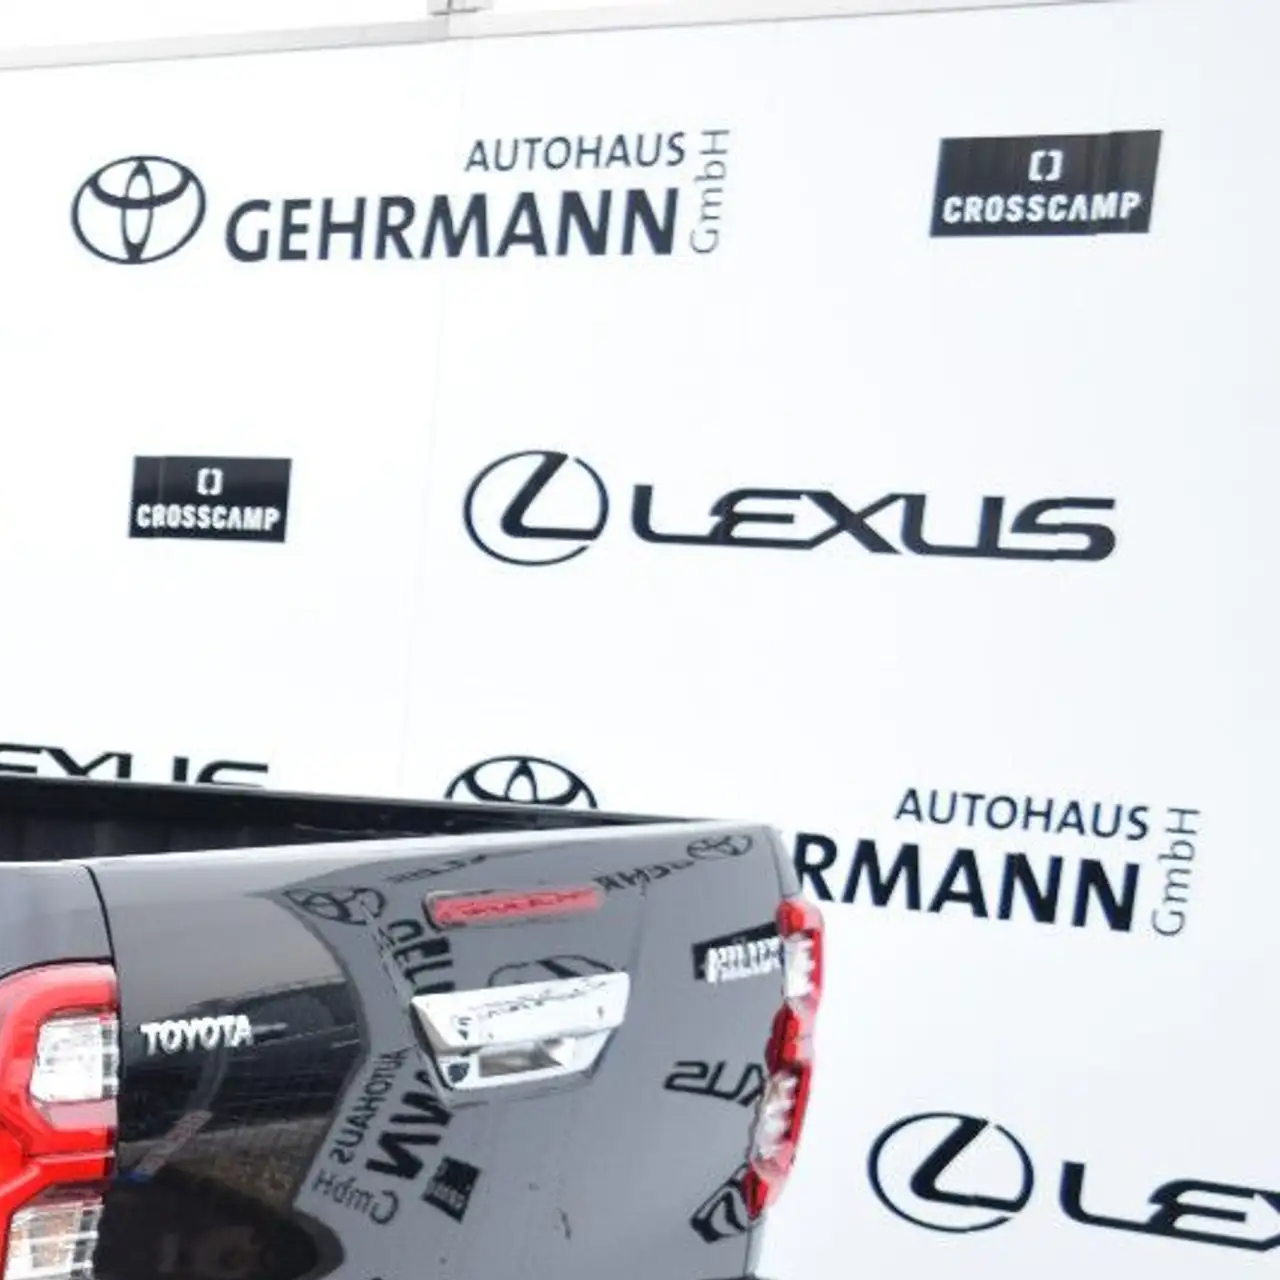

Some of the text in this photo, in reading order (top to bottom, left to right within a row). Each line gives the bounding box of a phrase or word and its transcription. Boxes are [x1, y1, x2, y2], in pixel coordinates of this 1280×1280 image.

[464, 131, 686, 172] AUTOHAUS
[689, 129, 731, 255] GmbH
[942, 191, 1142, 224] CROSSCAMP
[225, 187, 679, 263] GEHRMANN
[136, 503, 281, 531] CROSSCAMP
[631, 484, 1116, 562] LEXUS
[894, 787, 1149, 841] AUTOHAUS
[1151, 807, 1201, 937] GmbH
[141, 1014, 255, 1054] TOYOTA
